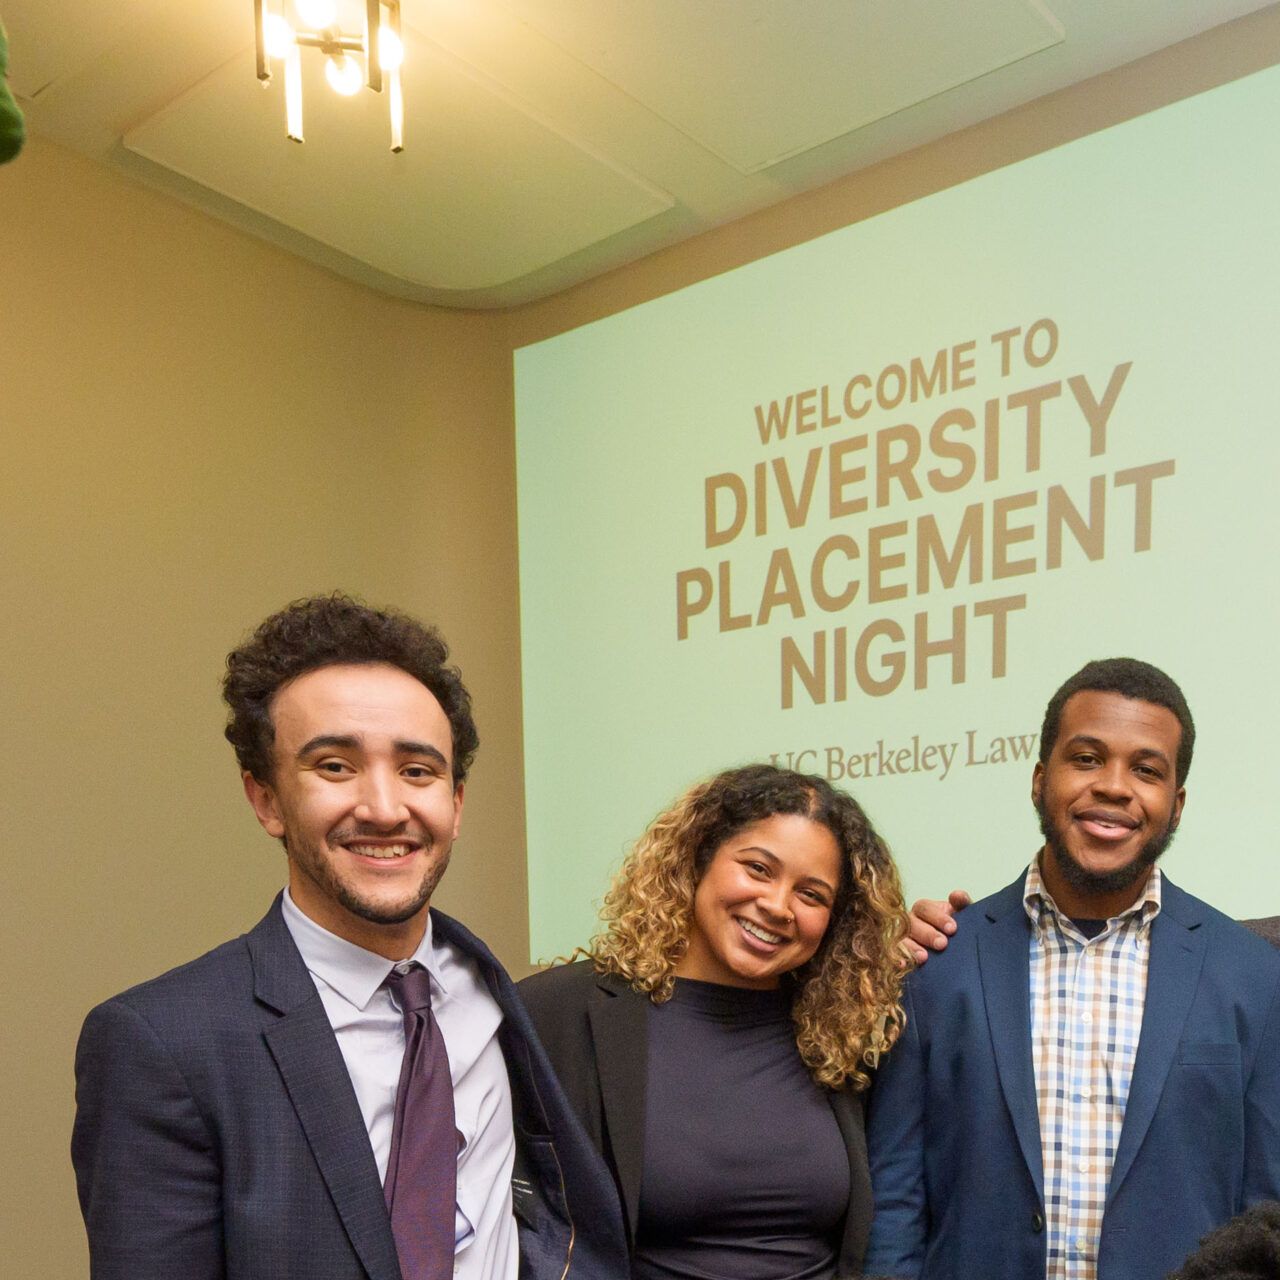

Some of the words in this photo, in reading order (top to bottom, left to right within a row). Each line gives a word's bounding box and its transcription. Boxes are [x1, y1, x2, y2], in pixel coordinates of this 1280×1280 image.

[753, 339, 977, 445] WELCOME
[990, 317, 1059, 377] TO
[703, 360, 1133, 549] DIVERSITY
[674, 458, 1176, 642] PLACEMENT
[780, 593, 1027, 710] NIGHT
[824, 735, 959, 781] Berkeley
[965, 730, 1038, 767] Law
